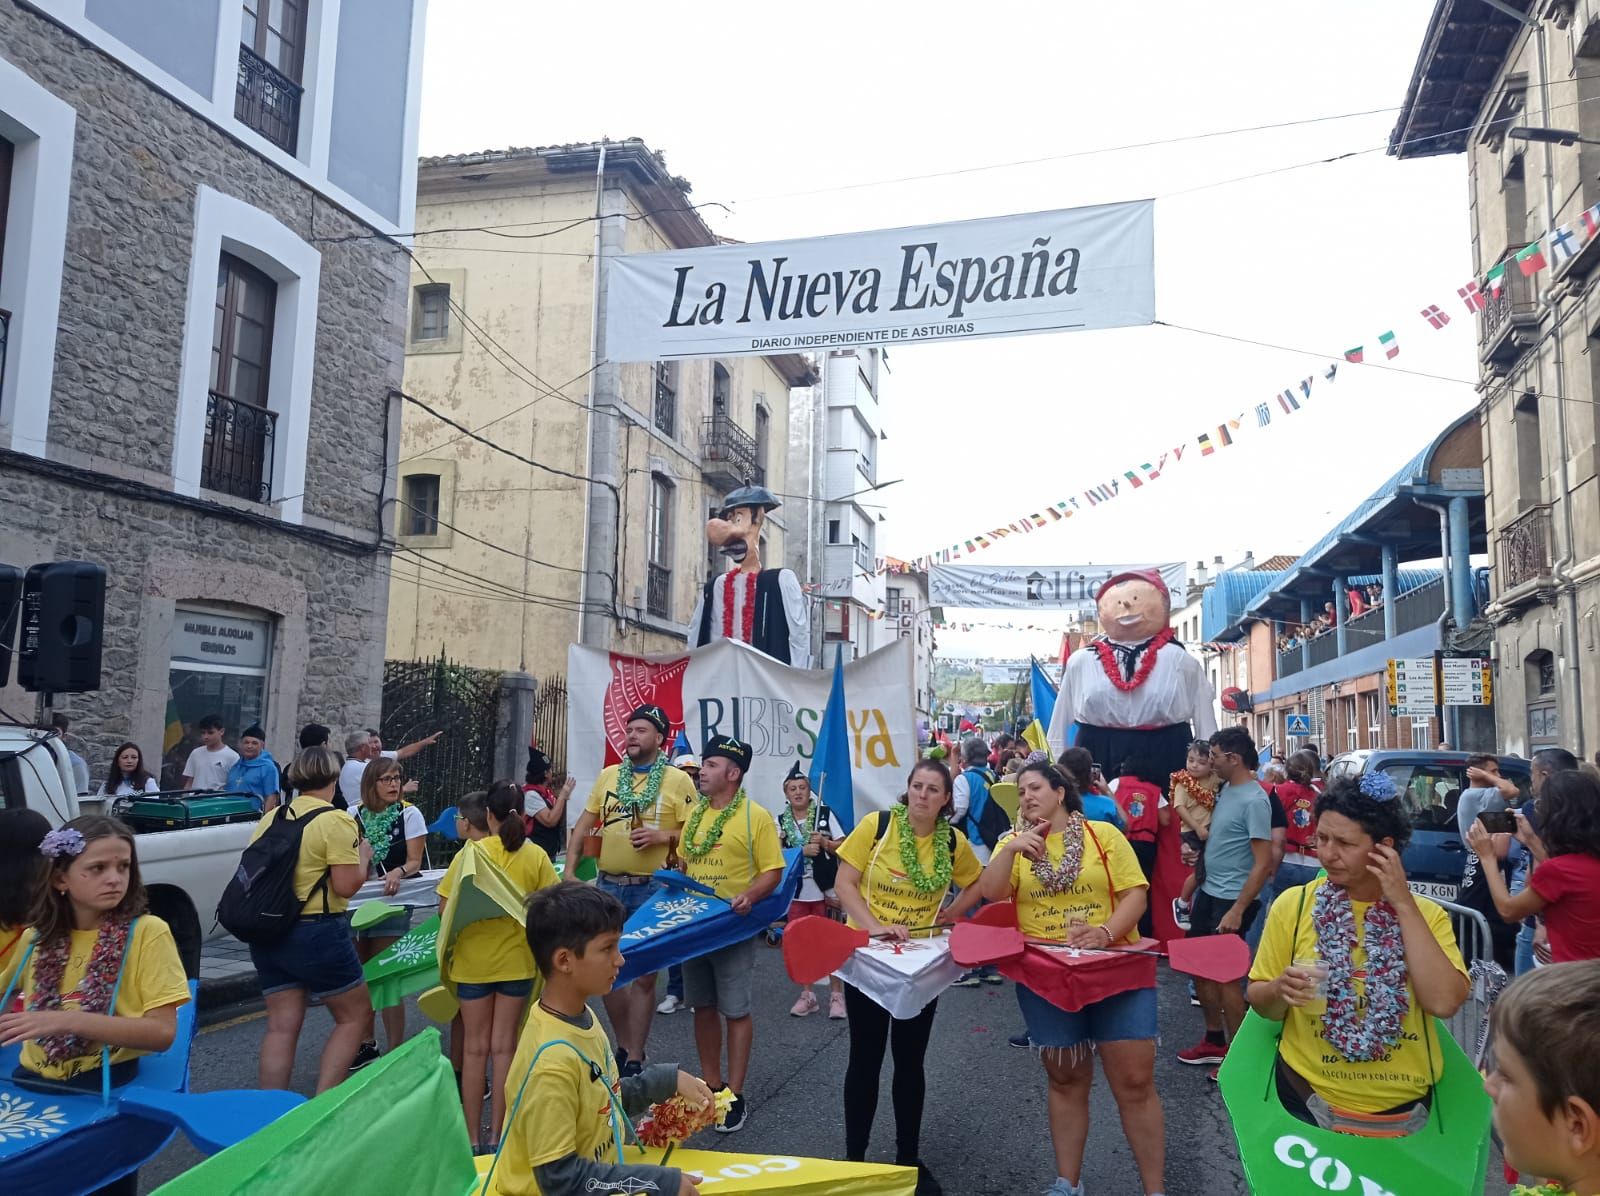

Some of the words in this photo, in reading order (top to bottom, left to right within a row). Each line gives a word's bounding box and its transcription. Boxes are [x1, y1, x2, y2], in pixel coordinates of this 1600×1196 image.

[662, 265, 725, 328] La
[736, 256, 882, 324] Nueva
[890, 235, 1082, 318] España
[751, 336, 792, 349] DIARIO
[794, 330, 888, 347] INDEPENDIENTE
[891, 328, 909, 340] DE
[911, 323, 975, 338] ASTURIAS
[877, 882, 904, 897] NUNCA
[907, 890, 933, 902] DIGAS
[1431, 885, 1455, 898] KGN
[1042, 905, 1060, 917] esta
[878, 914, 888, 922] no
[1045, 923, 1056, 932] no
[1321, 1053, 1340, 1064] no
